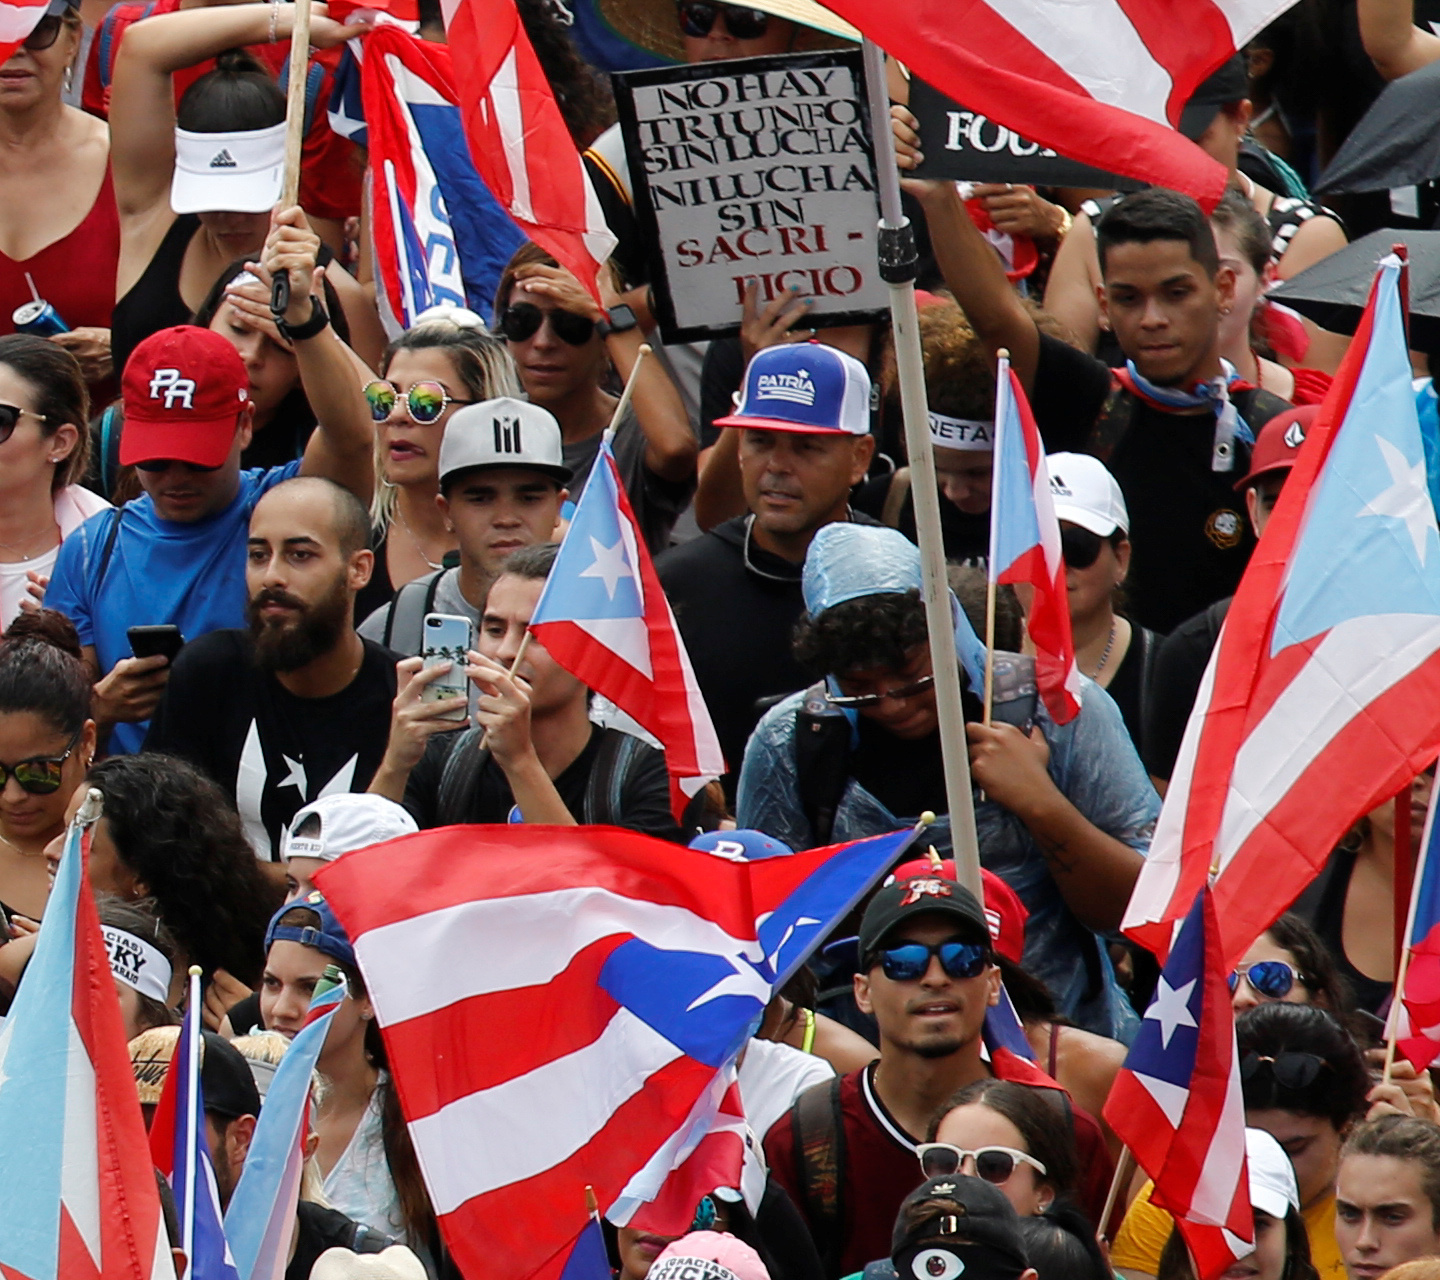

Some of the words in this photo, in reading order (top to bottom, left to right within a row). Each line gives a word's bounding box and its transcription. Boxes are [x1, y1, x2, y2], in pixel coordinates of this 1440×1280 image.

[658, 80, 729, 114] NO
[734, 70, 835, 101] HAY
[640, 98, 861, 145] TRIUNFO
[644, 138, 725, 175] SIN
[726, 127, 871, 163] LUCHA
[651, 177, 707, 211] NI
[707, 165, 875, 205] LUCHA
[718, 198, 806, 233] SIN
[677, 224, 831, 268] SACRI
[758, 372, 815, 391] PATRIA
